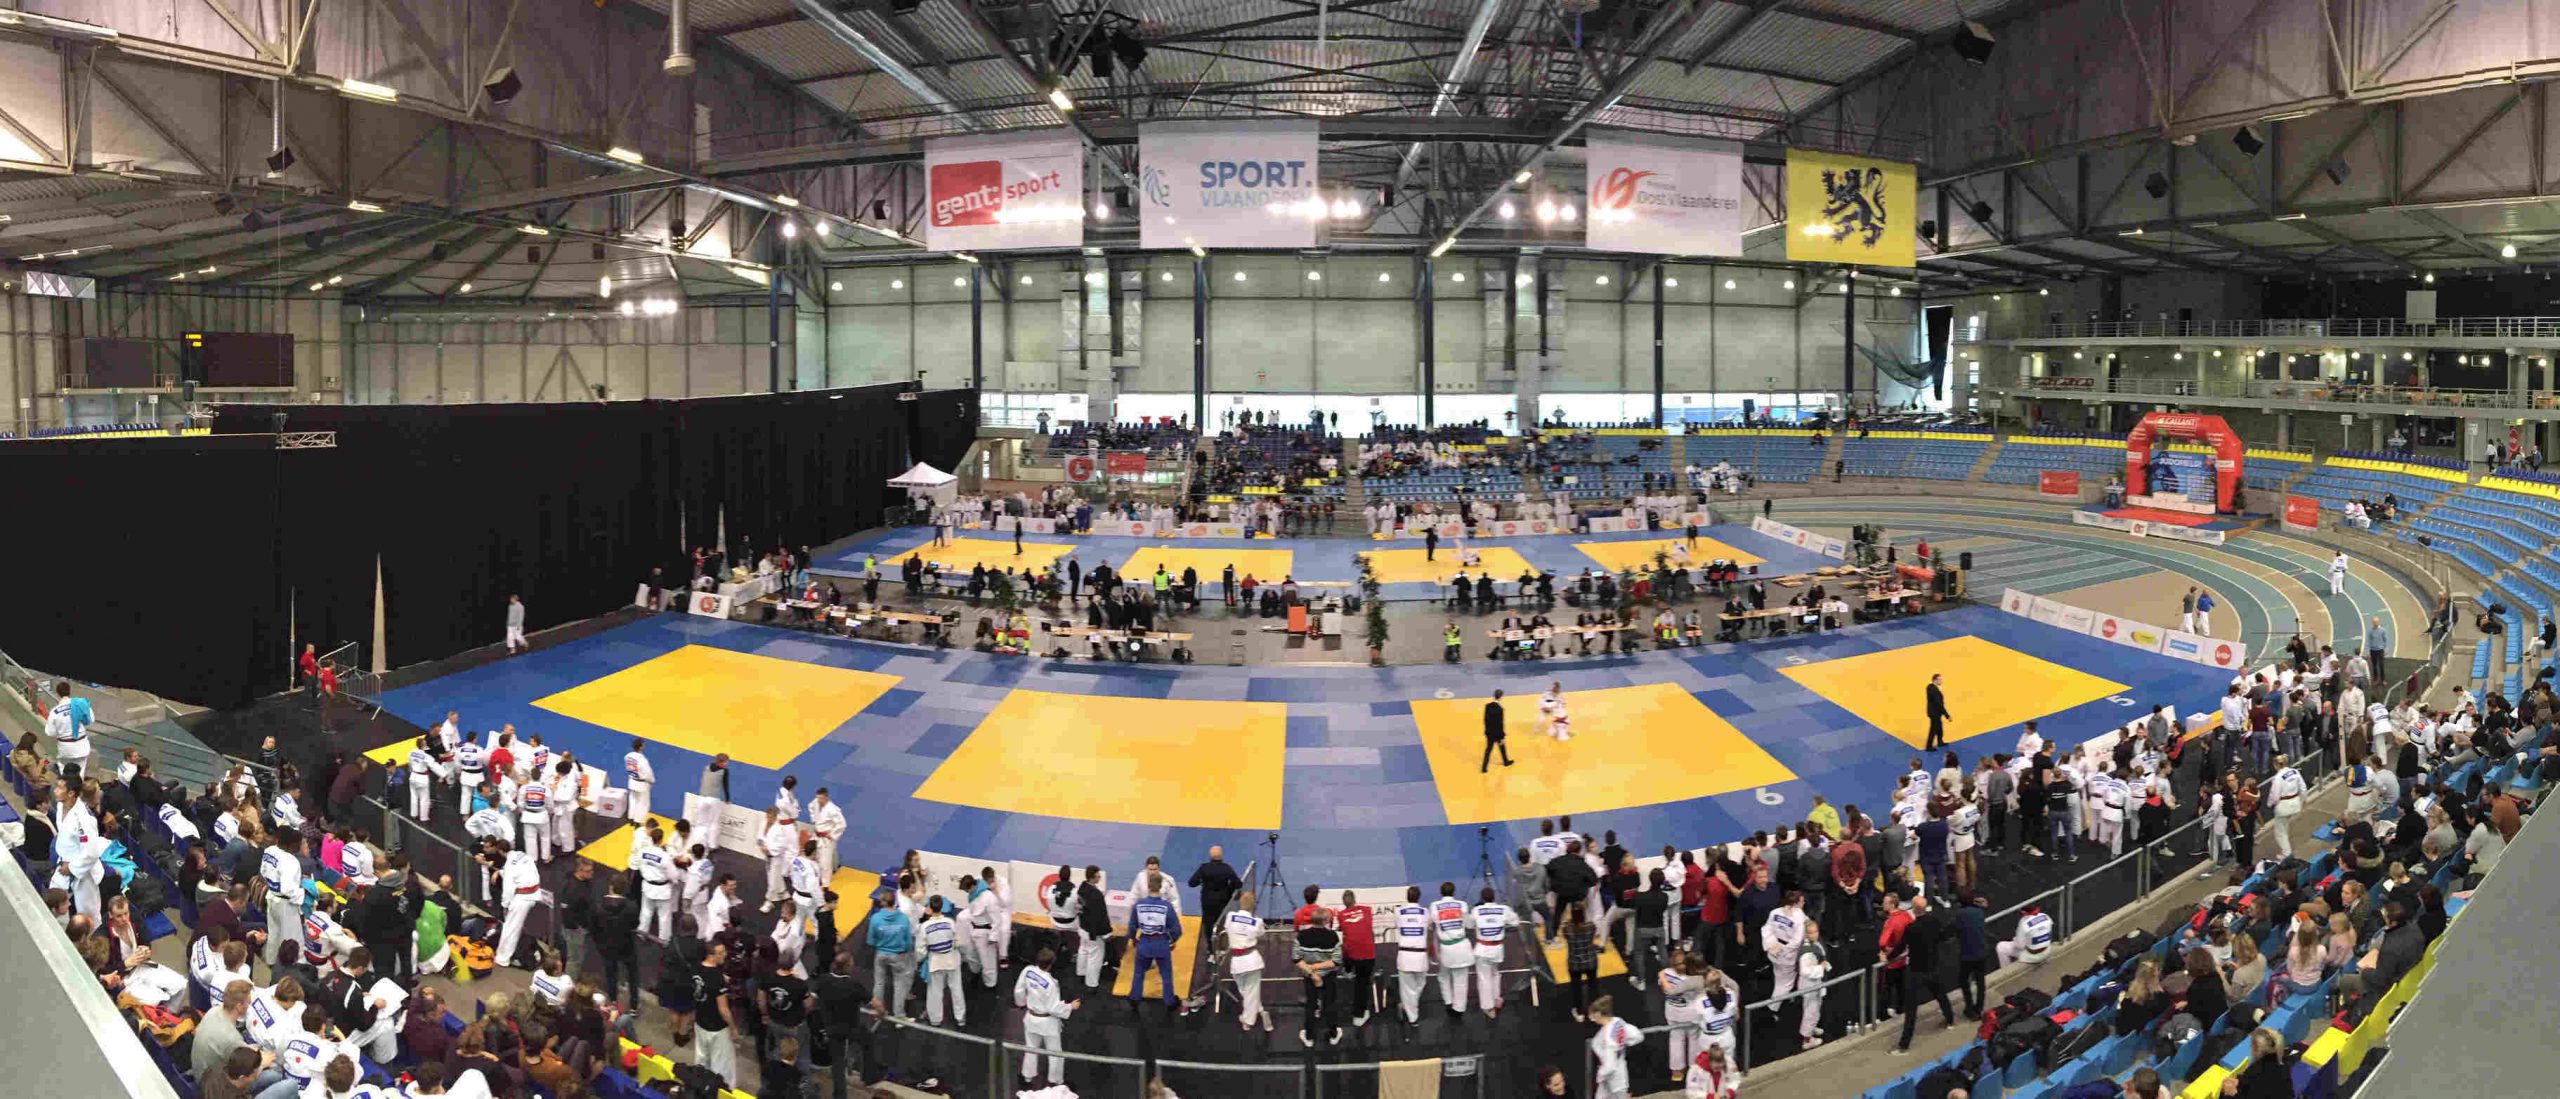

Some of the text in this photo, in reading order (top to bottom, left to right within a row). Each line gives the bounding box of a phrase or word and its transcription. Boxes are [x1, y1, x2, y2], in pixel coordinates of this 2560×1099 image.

[936, 170, 1061, 225] gent: sport
[2105, 695, 2136, 706] 5
[1755, 787, 1784, 805] 6
